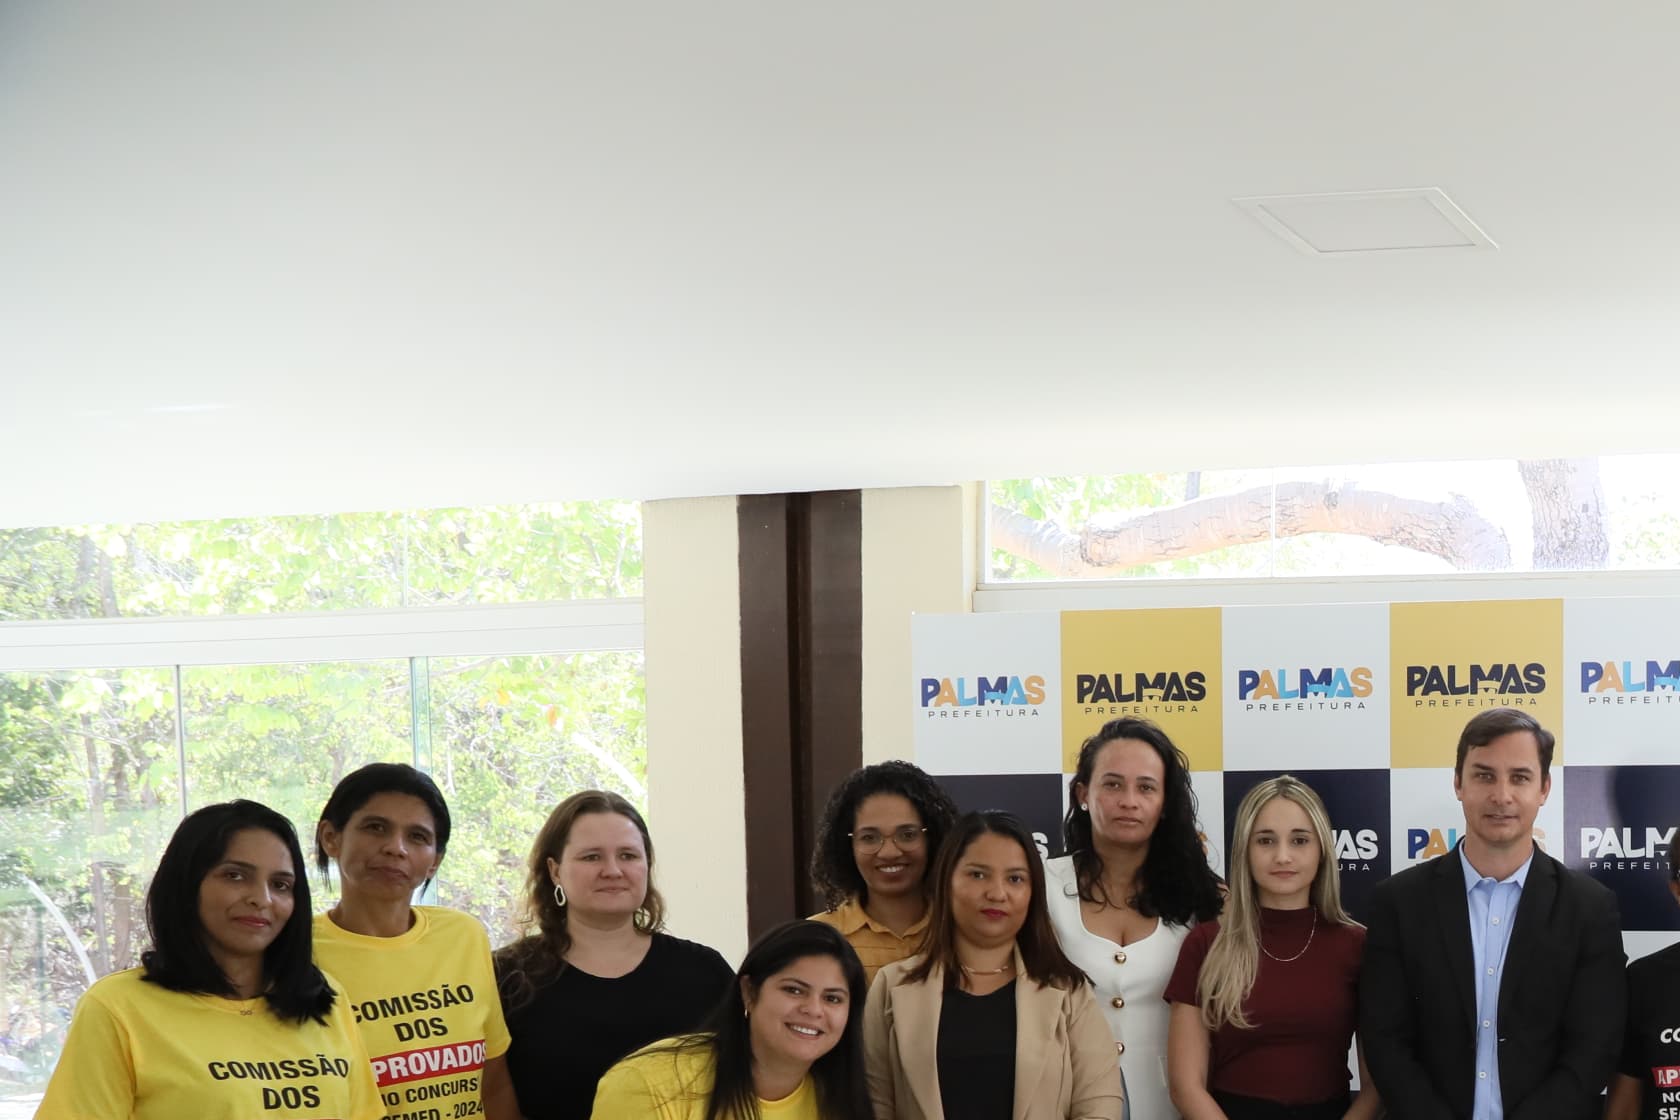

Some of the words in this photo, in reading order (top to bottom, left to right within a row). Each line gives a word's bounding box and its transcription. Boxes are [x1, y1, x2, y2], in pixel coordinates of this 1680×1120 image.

[921, 676, 1046, 707] PALMAS
[1076, 671, 1207, 703] PALMAS
[1238, 667, 1373, 700] PALMAS
[1406, 663, 1546, 696] PALMAS
[928, 709, 1039, 718] PREFEITURA
[1085, 705, 1199, 714] PREFEITURA
[1246, 702, 1366, 711] PREFEITURA
[1415, 698, 1537, 707] PREFEITURA
[393, 1017, 449, 1042] DOS
[207, 1054, 349, 1080] COMISSÃO
[262, 1085, 321, 1110] DOS
